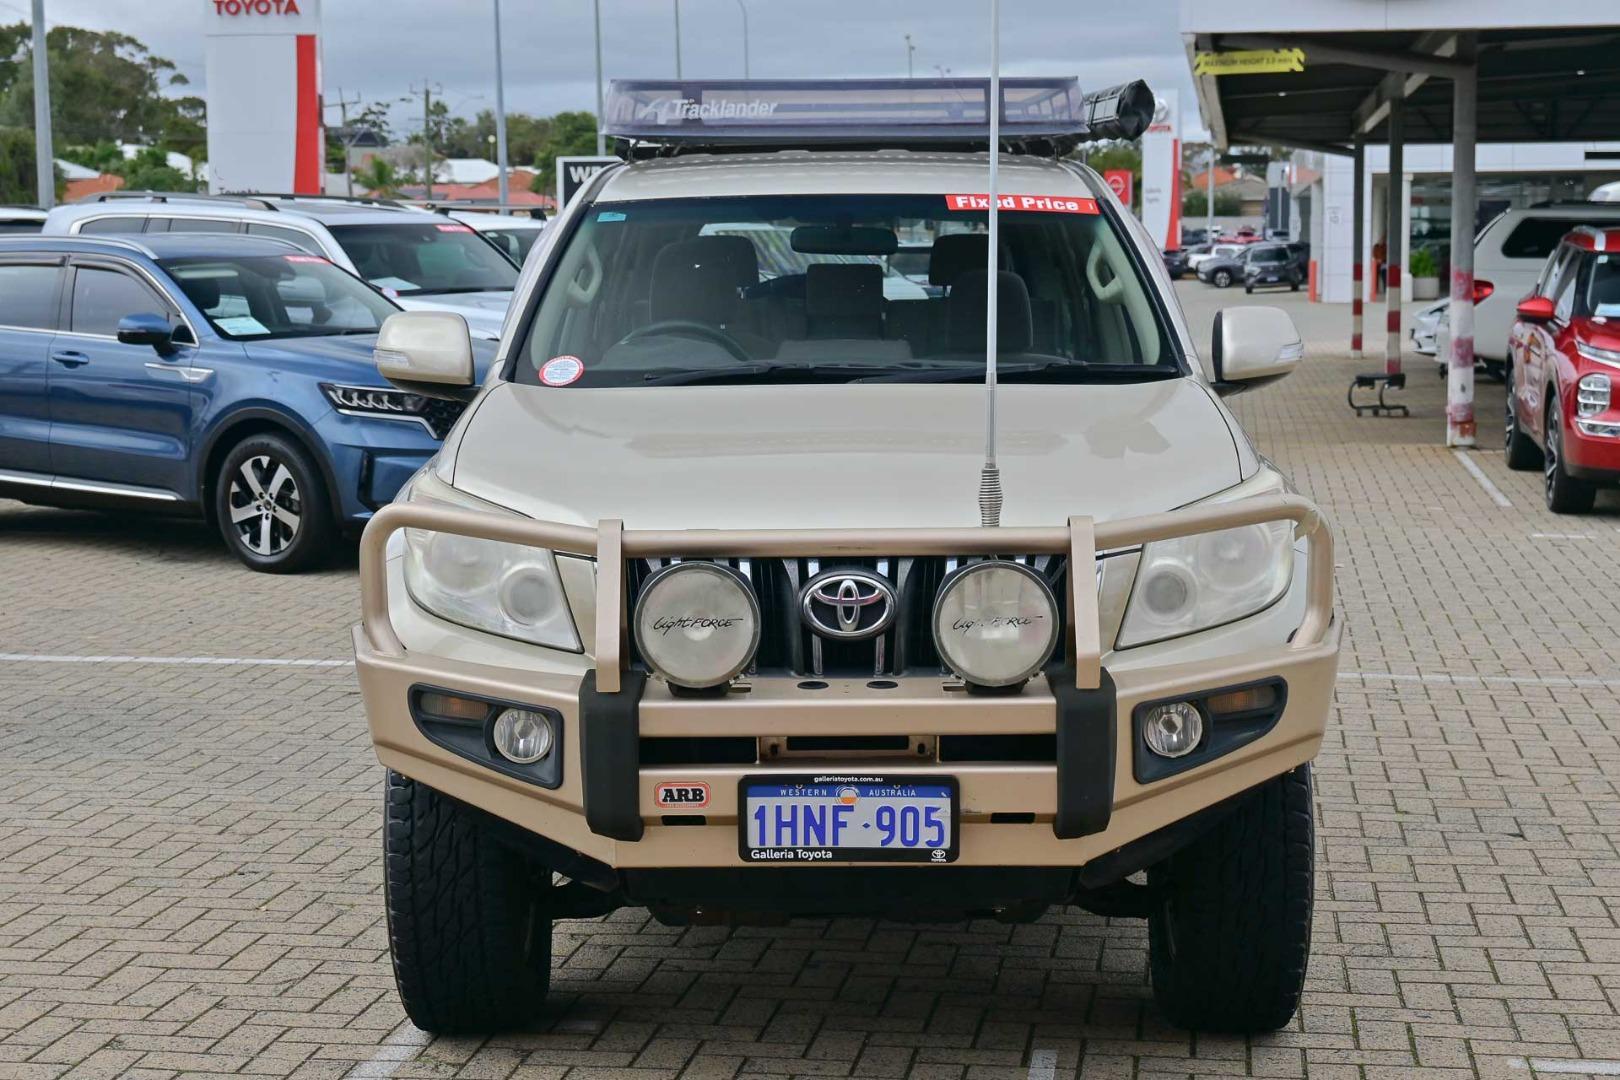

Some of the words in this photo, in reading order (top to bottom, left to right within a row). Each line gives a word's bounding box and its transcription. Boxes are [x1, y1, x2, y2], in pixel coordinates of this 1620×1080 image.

[213, 0, 300, 16] TOYOTA
[671, 98, 779, 120] Tracklander
[1021, 197, 1079, 211] Price
[813, 775, 884, 784] galleriatoyota.com.au
[661, 788, 705, 803] ARB
[780, 788, 828, 796] WESTERN
[868, 788, 917, 797] AUSTRALIA
[754, 804, 855, 847] 1HNF
[751, 849, 795, 859] Galleria
[796, 849, 833, 861] Toyota
